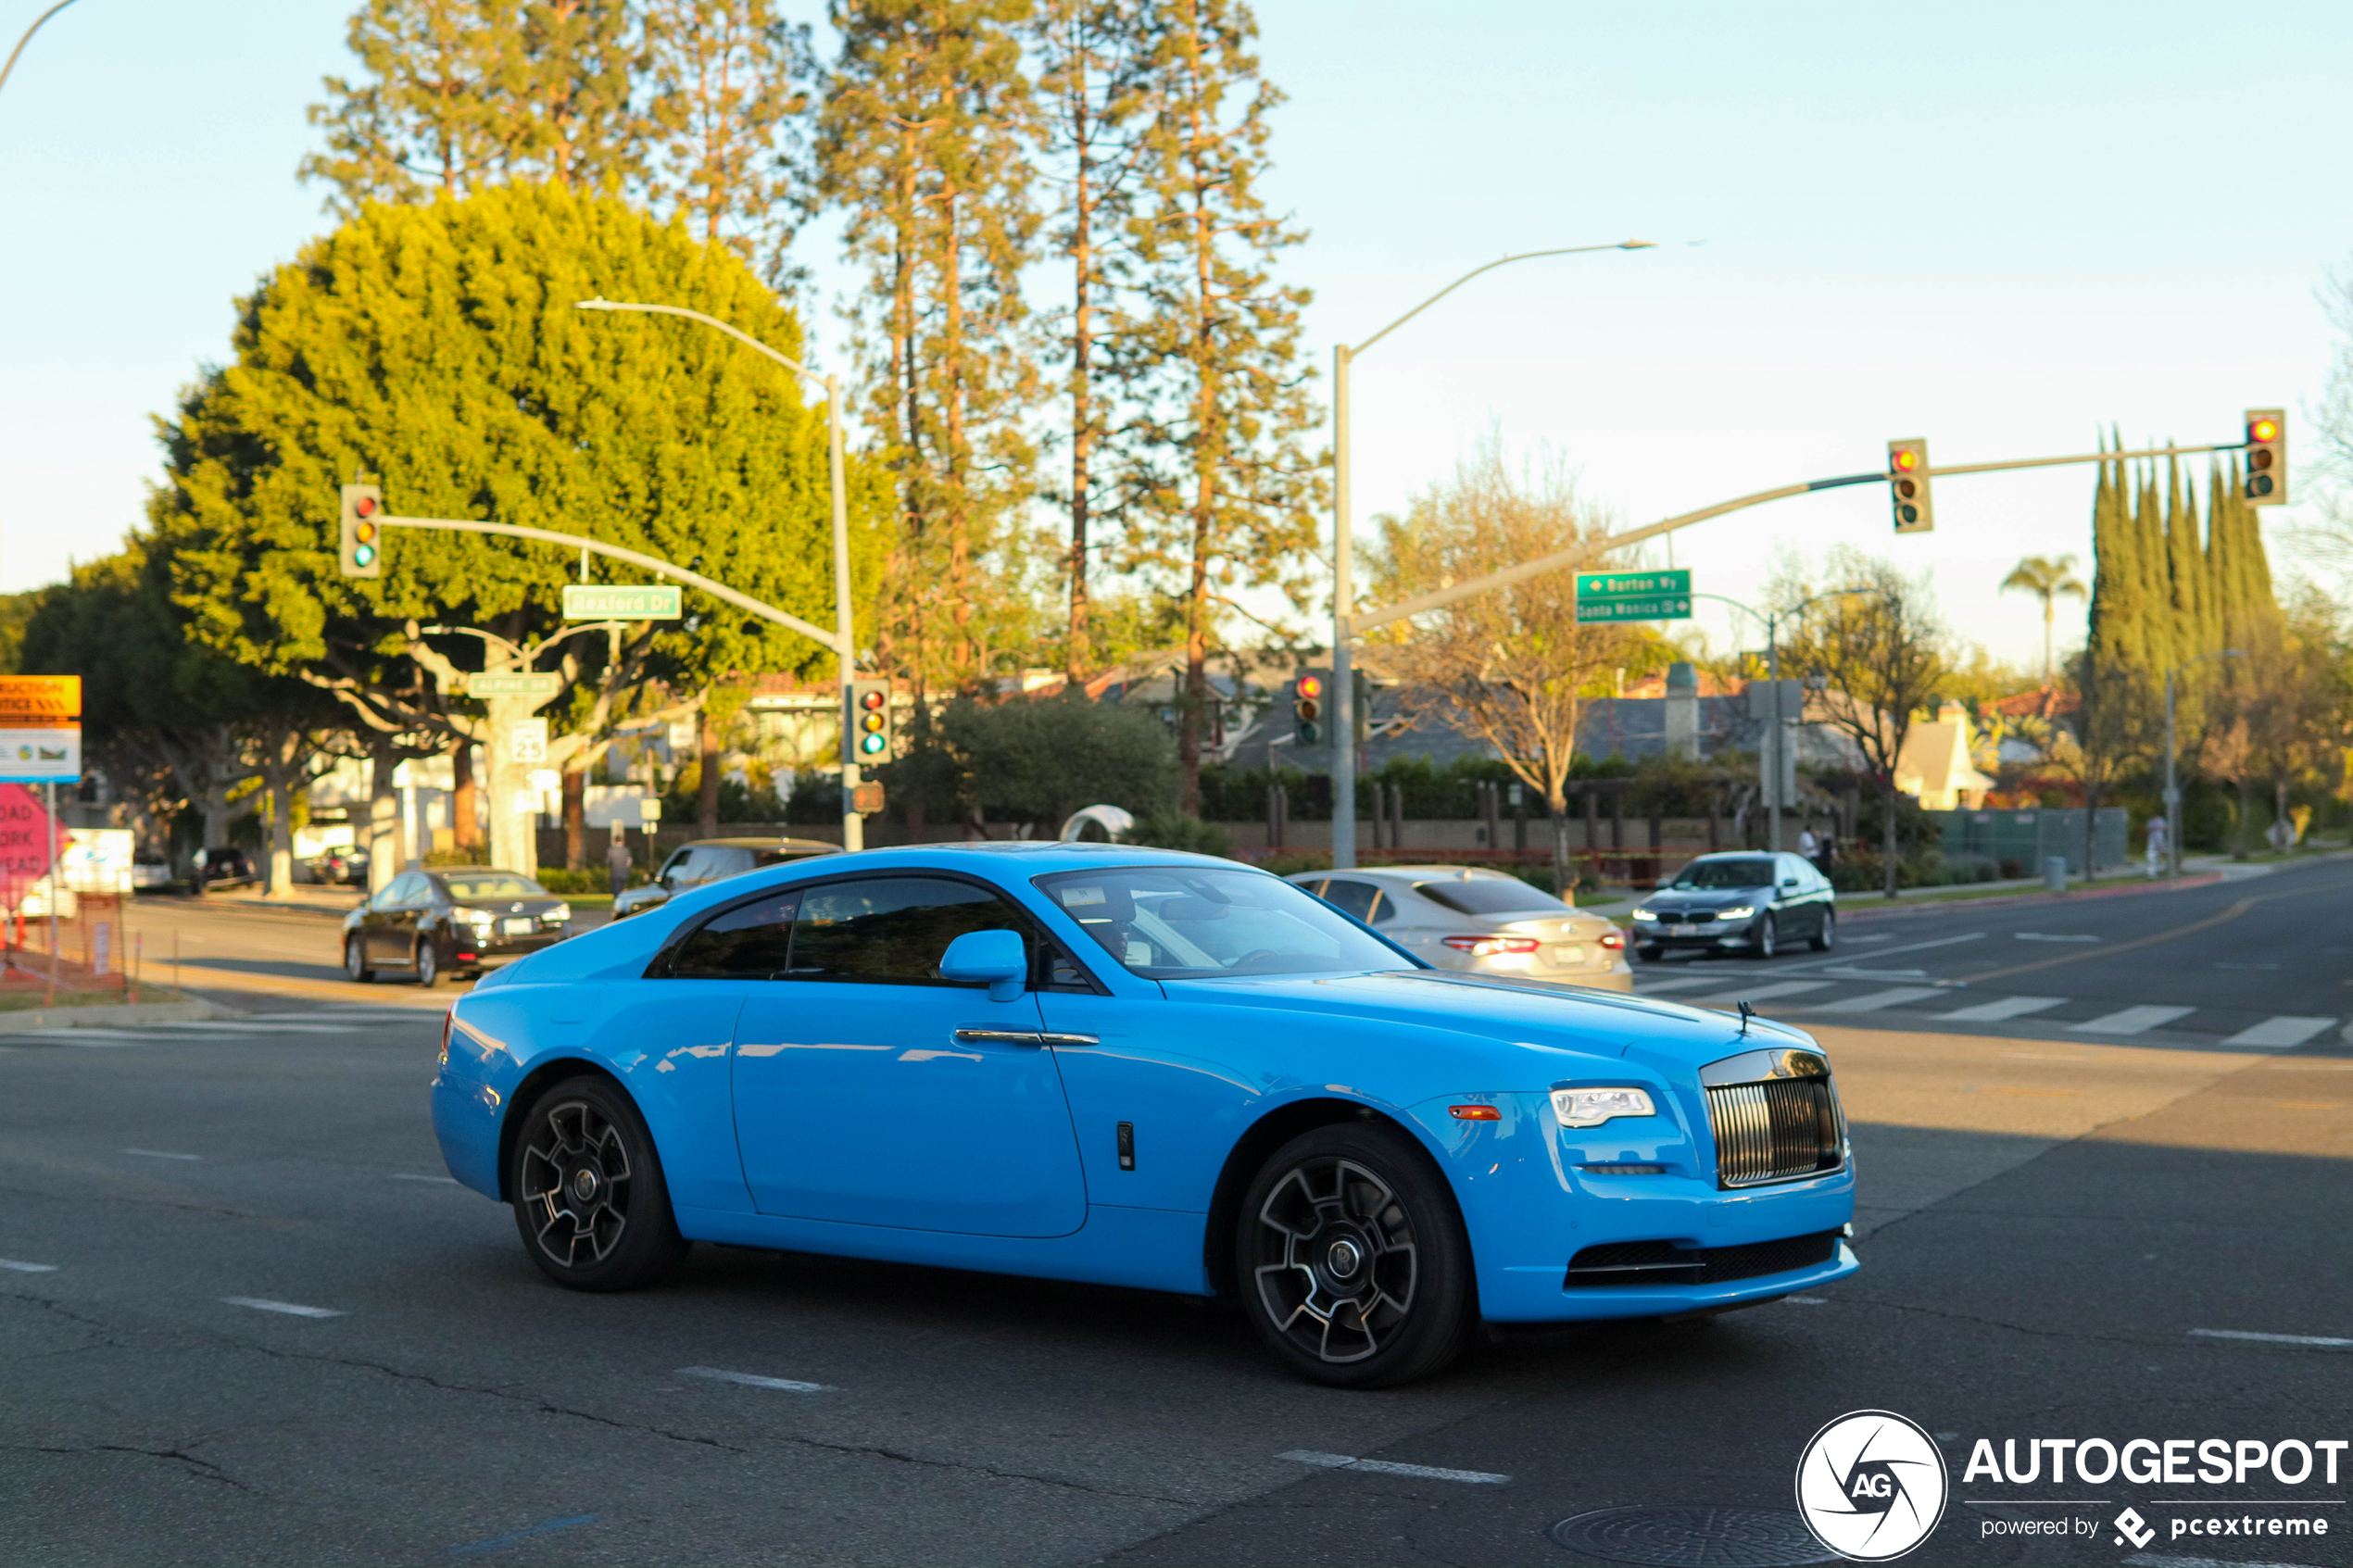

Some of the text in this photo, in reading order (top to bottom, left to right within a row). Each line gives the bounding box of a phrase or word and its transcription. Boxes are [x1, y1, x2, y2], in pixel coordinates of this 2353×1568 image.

[572, 594, 673, 611] Rexford Dr
[1578, 604, 1612, 618] Santa
[1615, 602, 1658, 615] Monica
[516, 742, 542, 758] 25
